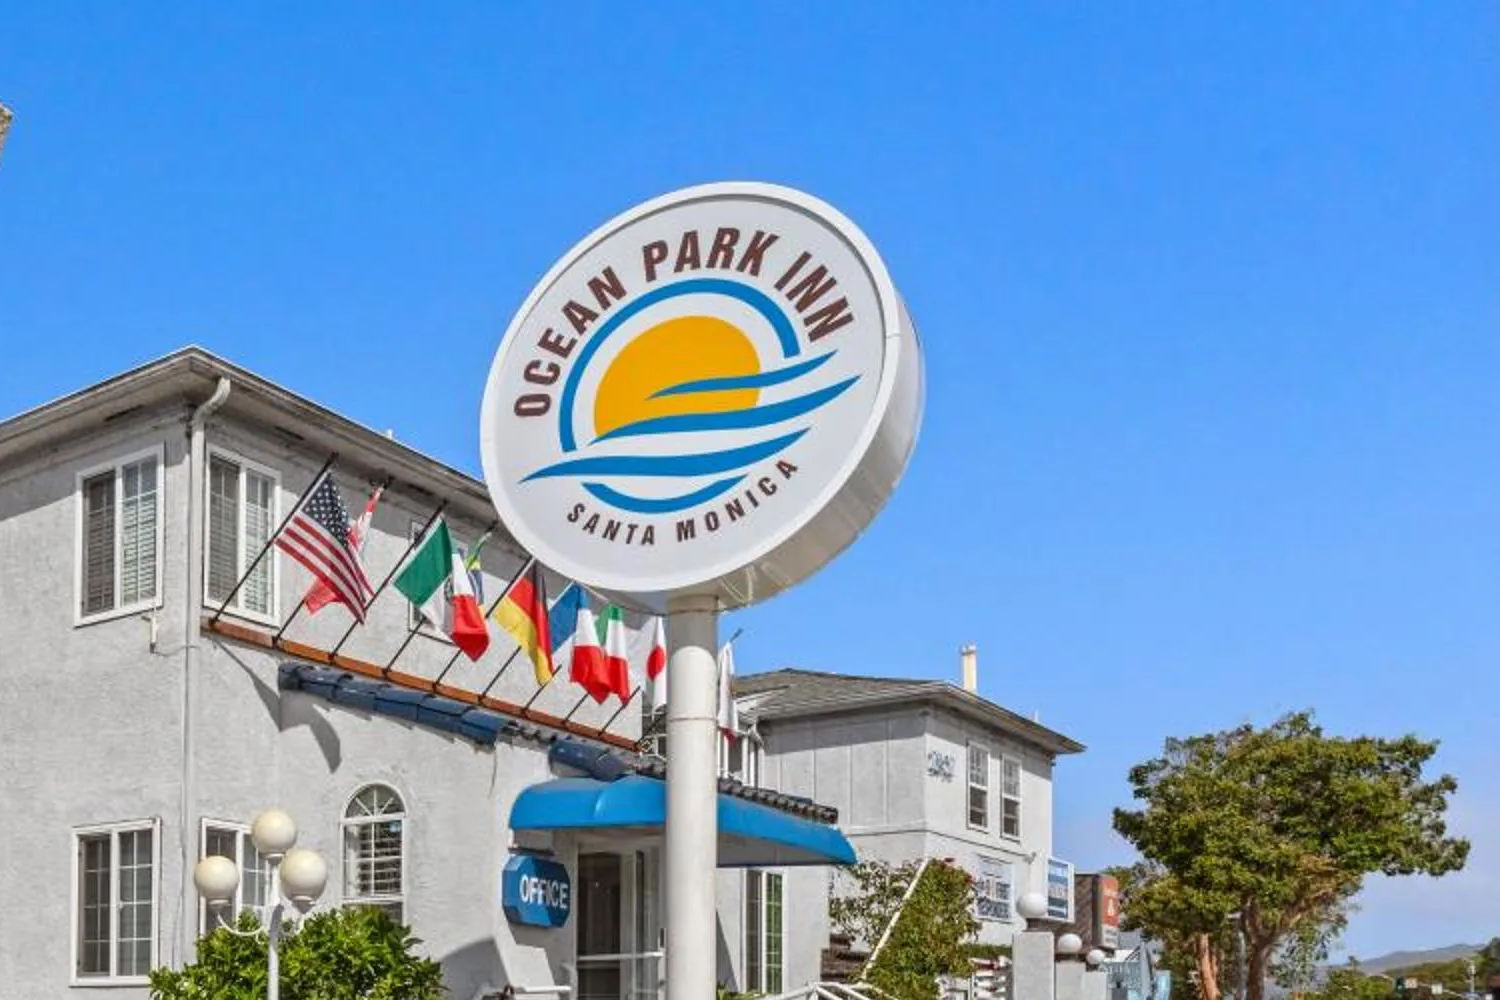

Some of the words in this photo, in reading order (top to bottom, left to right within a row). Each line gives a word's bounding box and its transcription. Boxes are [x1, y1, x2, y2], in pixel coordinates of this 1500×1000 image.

[513, 266, 628, 418] OCEAN
[642, 226, 781, 283] PARK
[773, 251, 854, 344] INN
[566, 502, 656, 546] SANTA
[676, 459, 799, 543] MONICA
[519, 873, 569, 910] OFFICE
